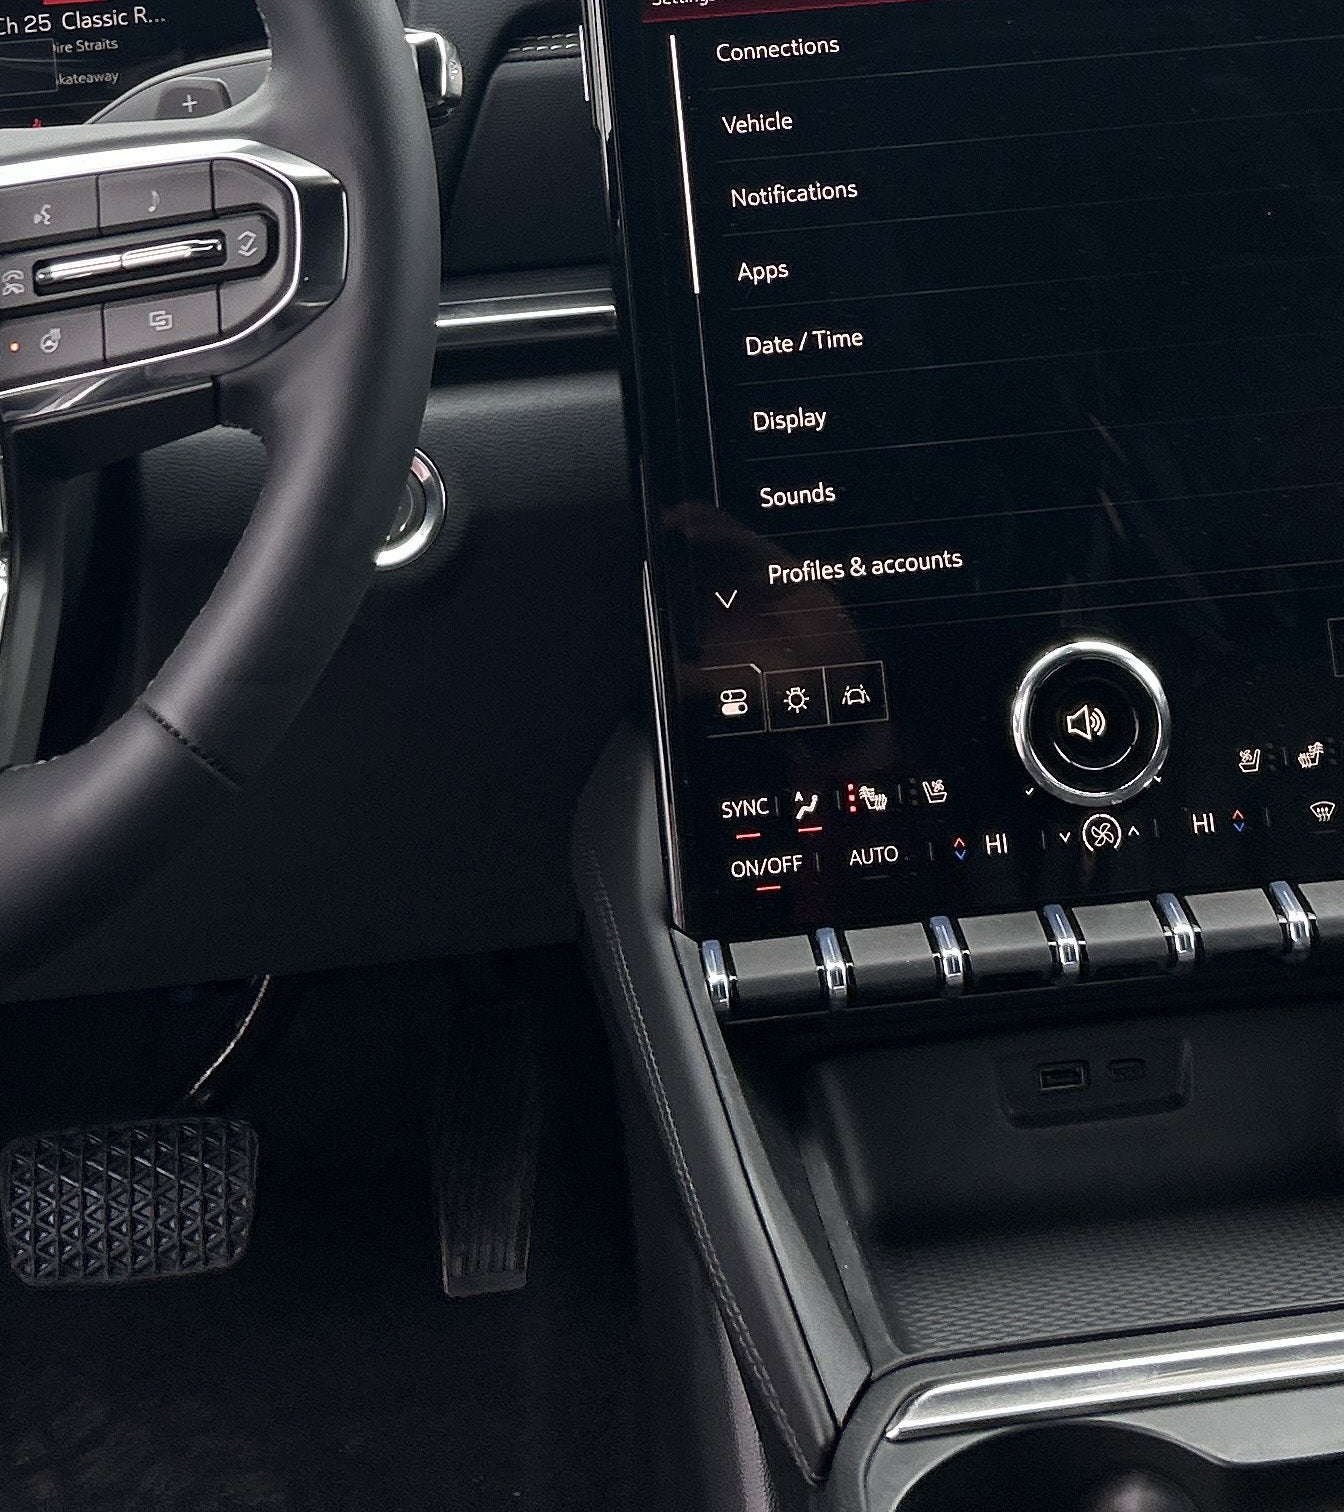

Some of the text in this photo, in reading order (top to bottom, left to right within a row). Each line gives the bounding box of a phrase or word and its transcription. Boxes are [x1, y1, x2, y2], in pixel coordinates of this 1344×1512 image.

[23, 13, 52, 33] 25
[61, 9, 129, 30] Classic
[76, 36, 120, 53] Straits
[716, 38, 840, 62] Connections
[721, 110, 793, 134] Vehicle
[730, 180, 858, 208] Notifications
[737, 261, 789, 286] Apps
[745, 329, 864, 356] Date / Time
[753, 406, 827, 434] Display
[759, 481, 836, 508] Sounds
[768, 549, 963, 585] Profiles & accounts
[721, 797, 770, 819] SYNC
[1192, 812, 1216, 835] HI
[849, 845, 899, 866] AUTO
[985, 832, 1008, 856] HI
[730, 854, 803, 878] ON/OFF
